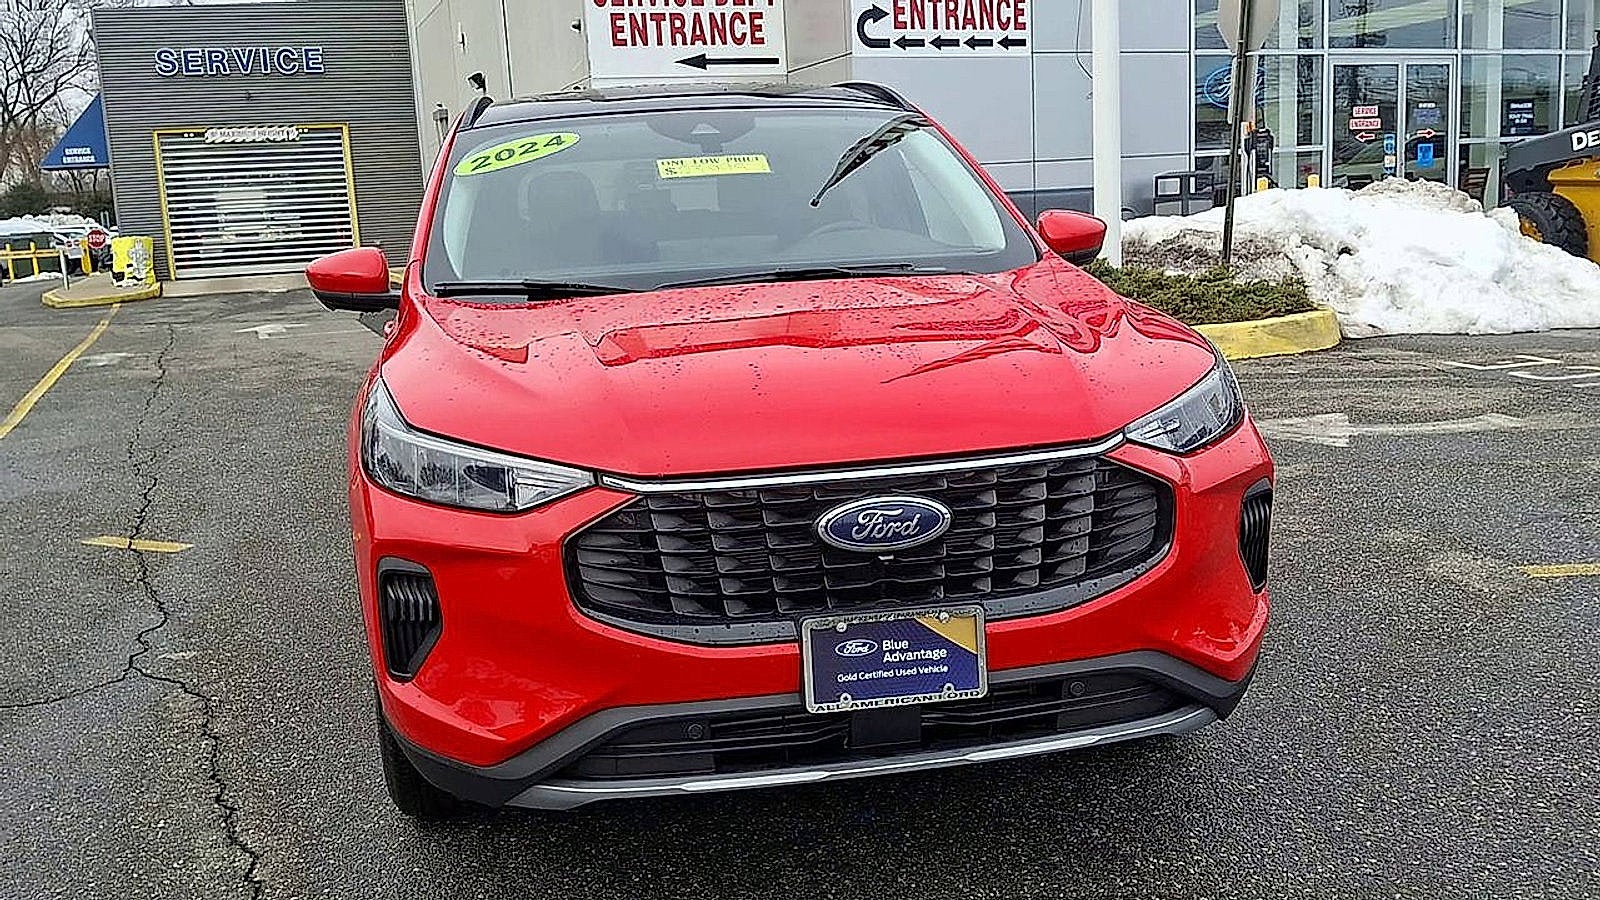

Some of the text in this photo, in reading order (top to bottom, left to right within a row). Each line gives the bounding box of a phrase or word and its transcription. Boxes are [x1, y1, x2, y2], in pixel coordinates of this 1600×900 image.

[893, 0, 1027, 31] ENTRANCE
[609, 11, 766, 47] ENTRANCE
[154, 46, 325, 76] SERVICE
[1354, 107, 1377, 115] SERVICE
[470, 134, 568, 171] 2024
[88, 233, 105, 243] STOP
[851, 508, 922, 540] Ford
[882, 639, 909, 651] Blue
[883, 649, 948, 663] Advantage
[837, 664, 949, 682] Gold Certified Used Vehicle
[850, 695, 932, 709] AMERICAN
